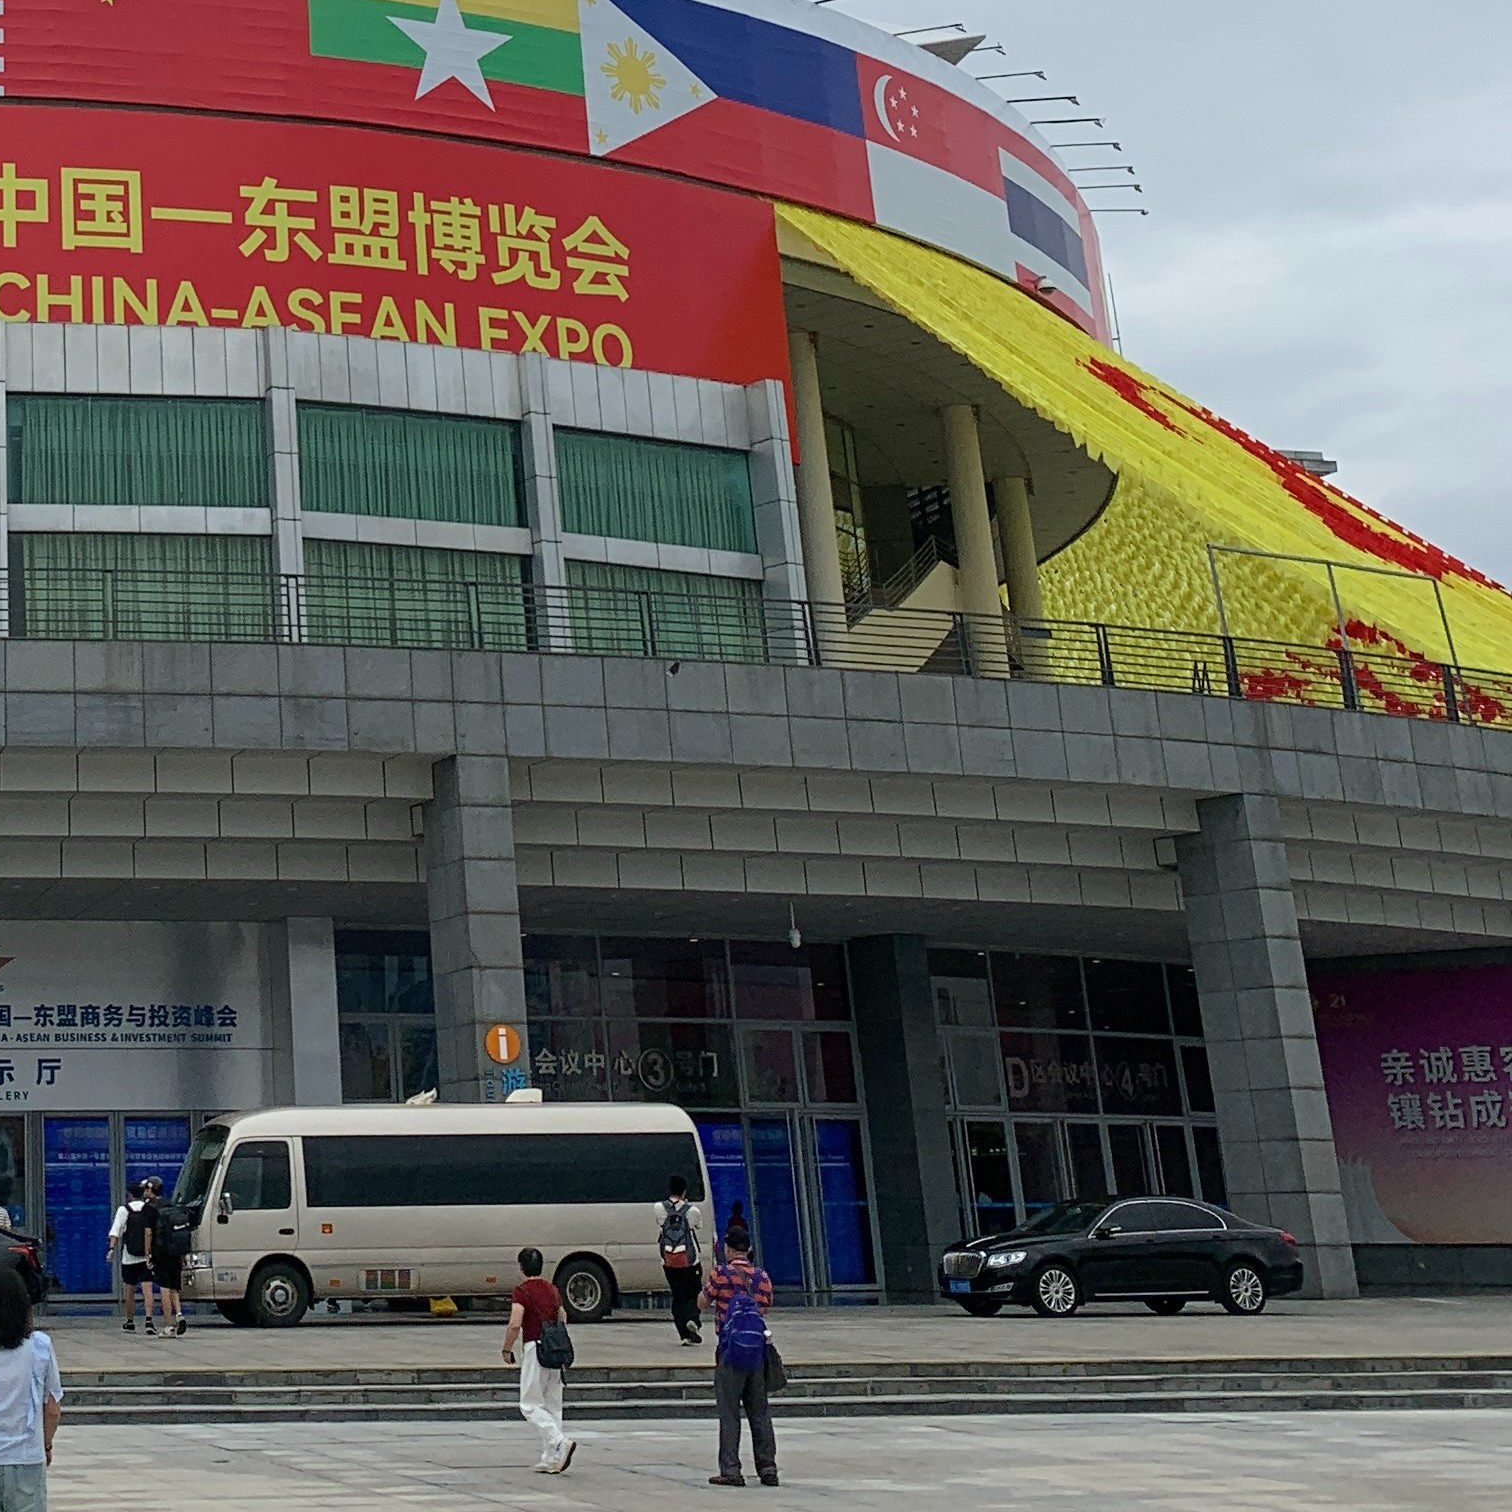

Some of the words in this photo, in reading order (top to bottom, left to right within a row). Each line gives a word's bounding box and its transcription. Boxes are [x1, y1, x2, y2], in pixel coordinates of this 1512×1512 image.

[477, 305, 634, 369] EXPO
[54, 1032, 107, 1043] BUSINESS
[190, 1032, 233, 1043] SUMMIT
[1388, 1090, 1512, 1130] 镶钻成
